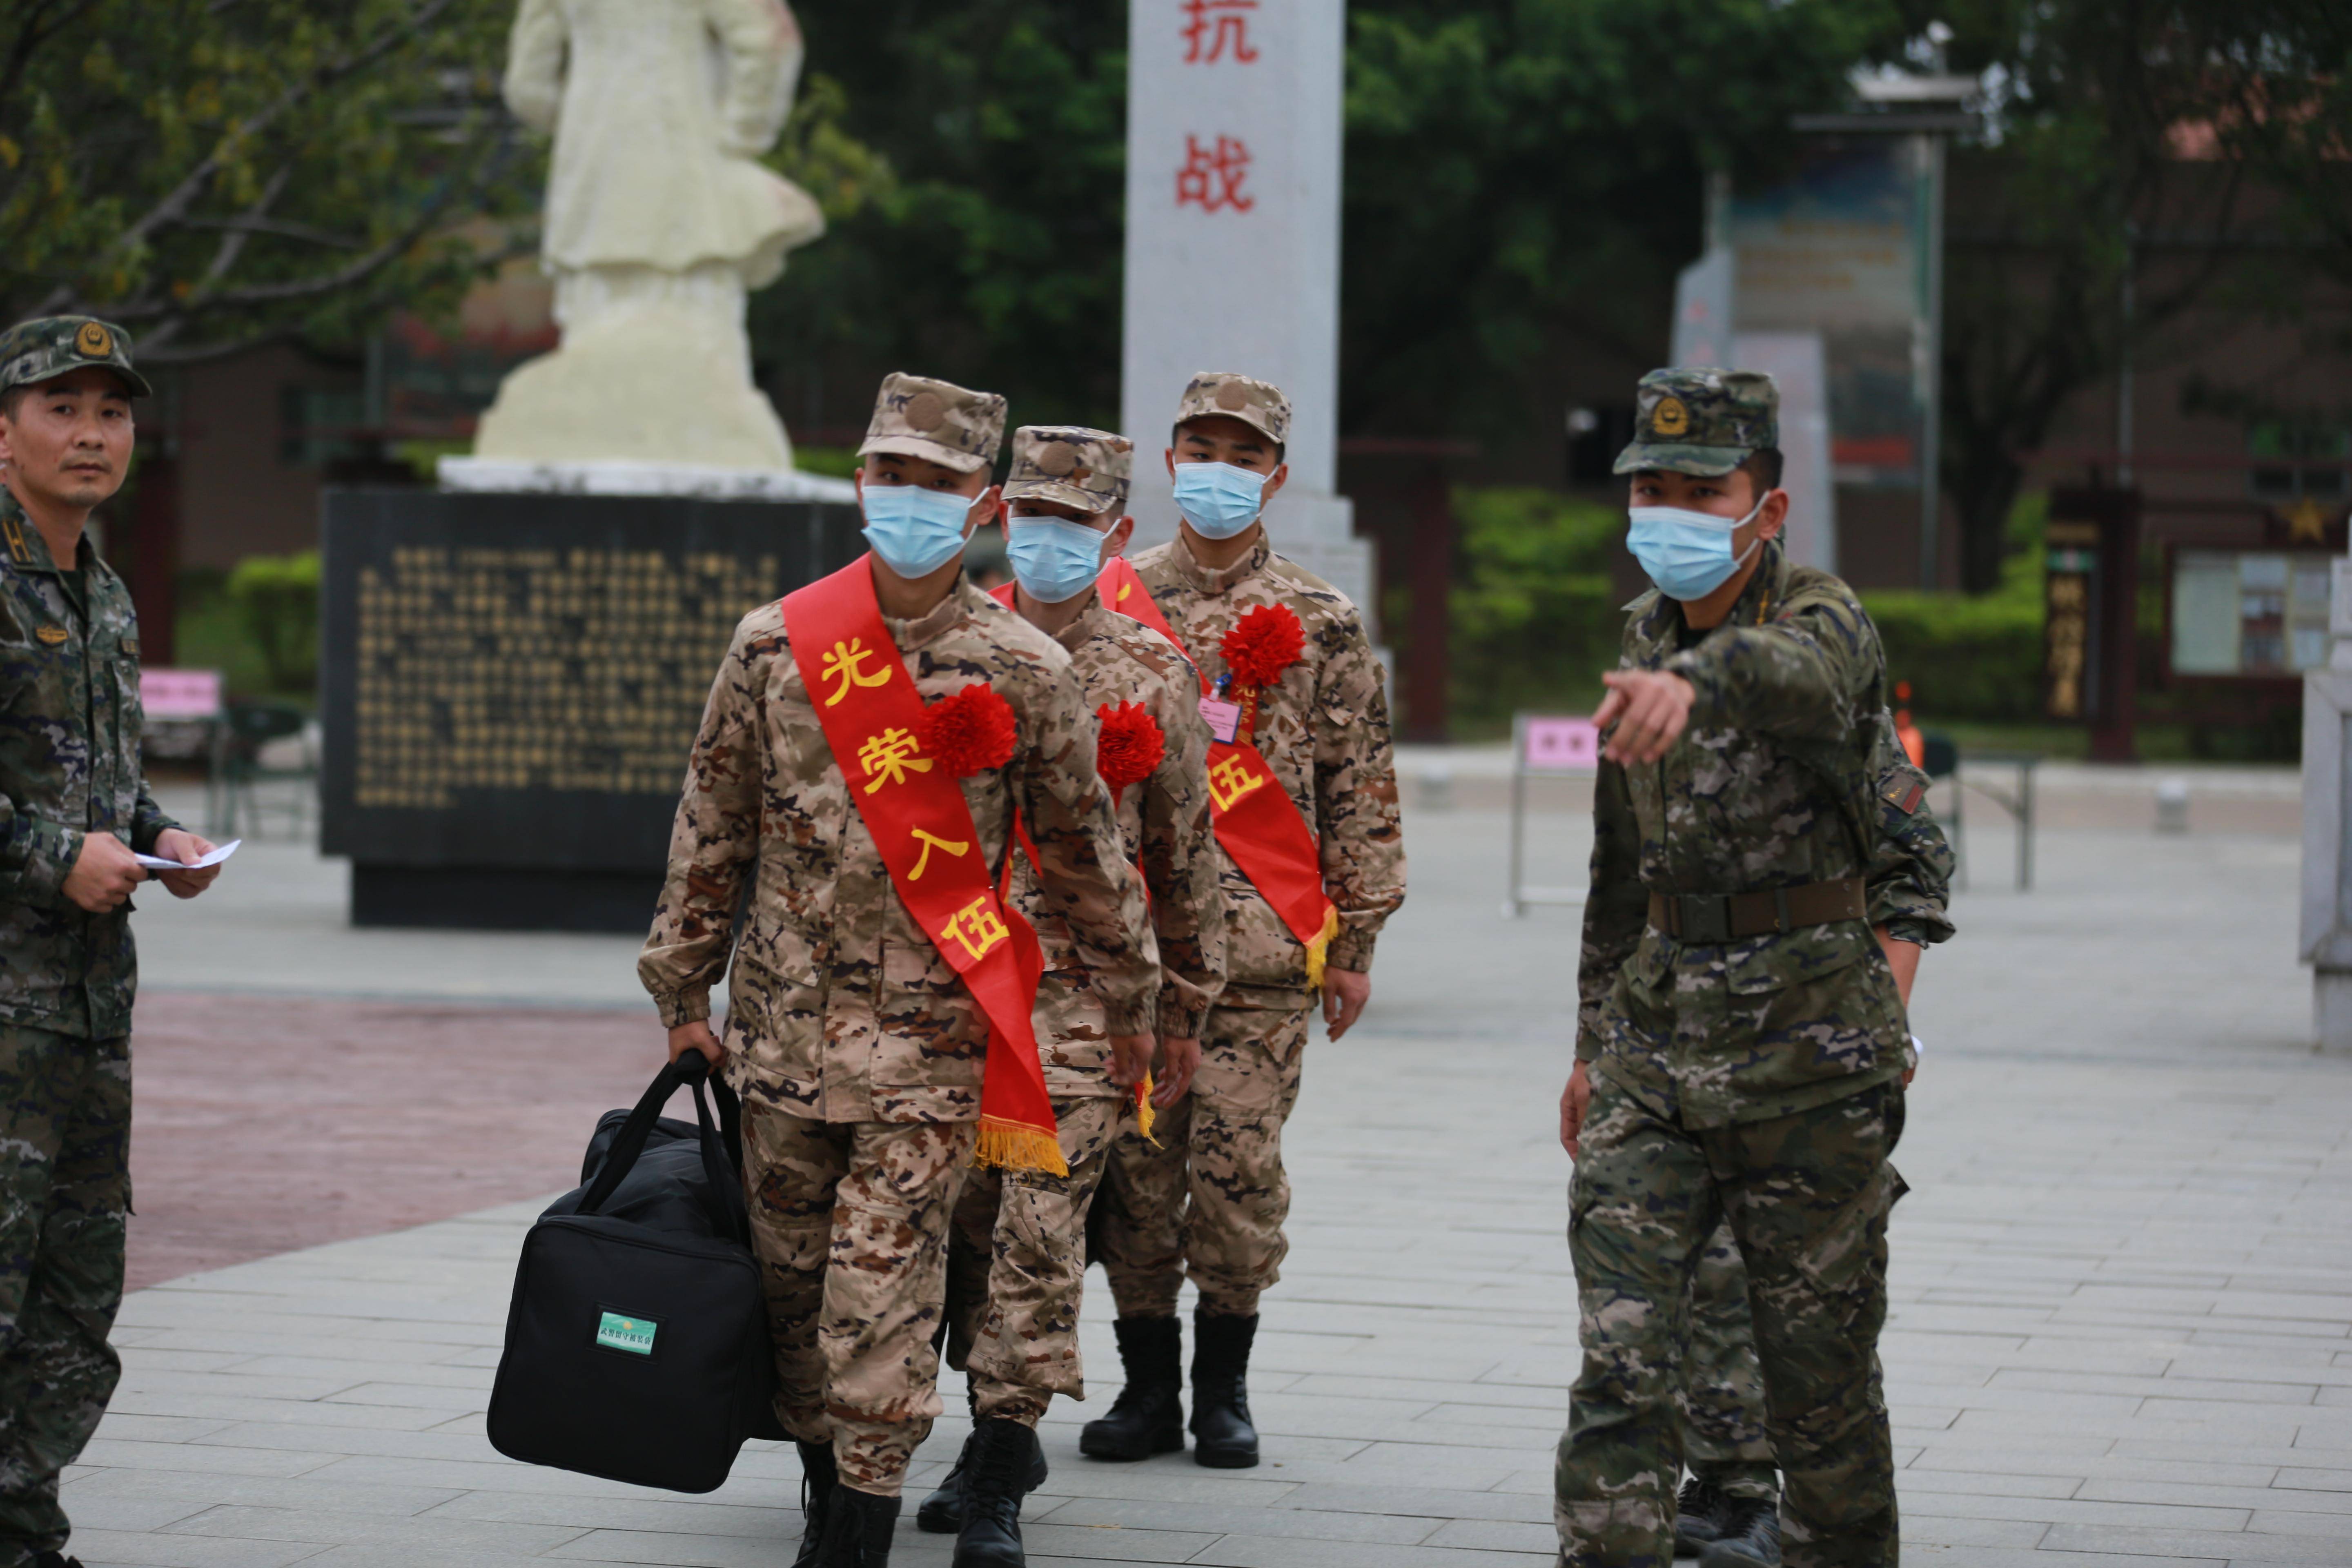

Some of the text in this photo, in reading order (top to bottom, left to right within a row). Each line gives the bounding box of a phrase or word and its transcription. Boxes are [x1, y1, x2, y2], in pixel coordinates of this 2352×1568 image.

[1175, 0, 1259, 214] 抗战
[821, 637, 1011, 961] 光荣入伍
